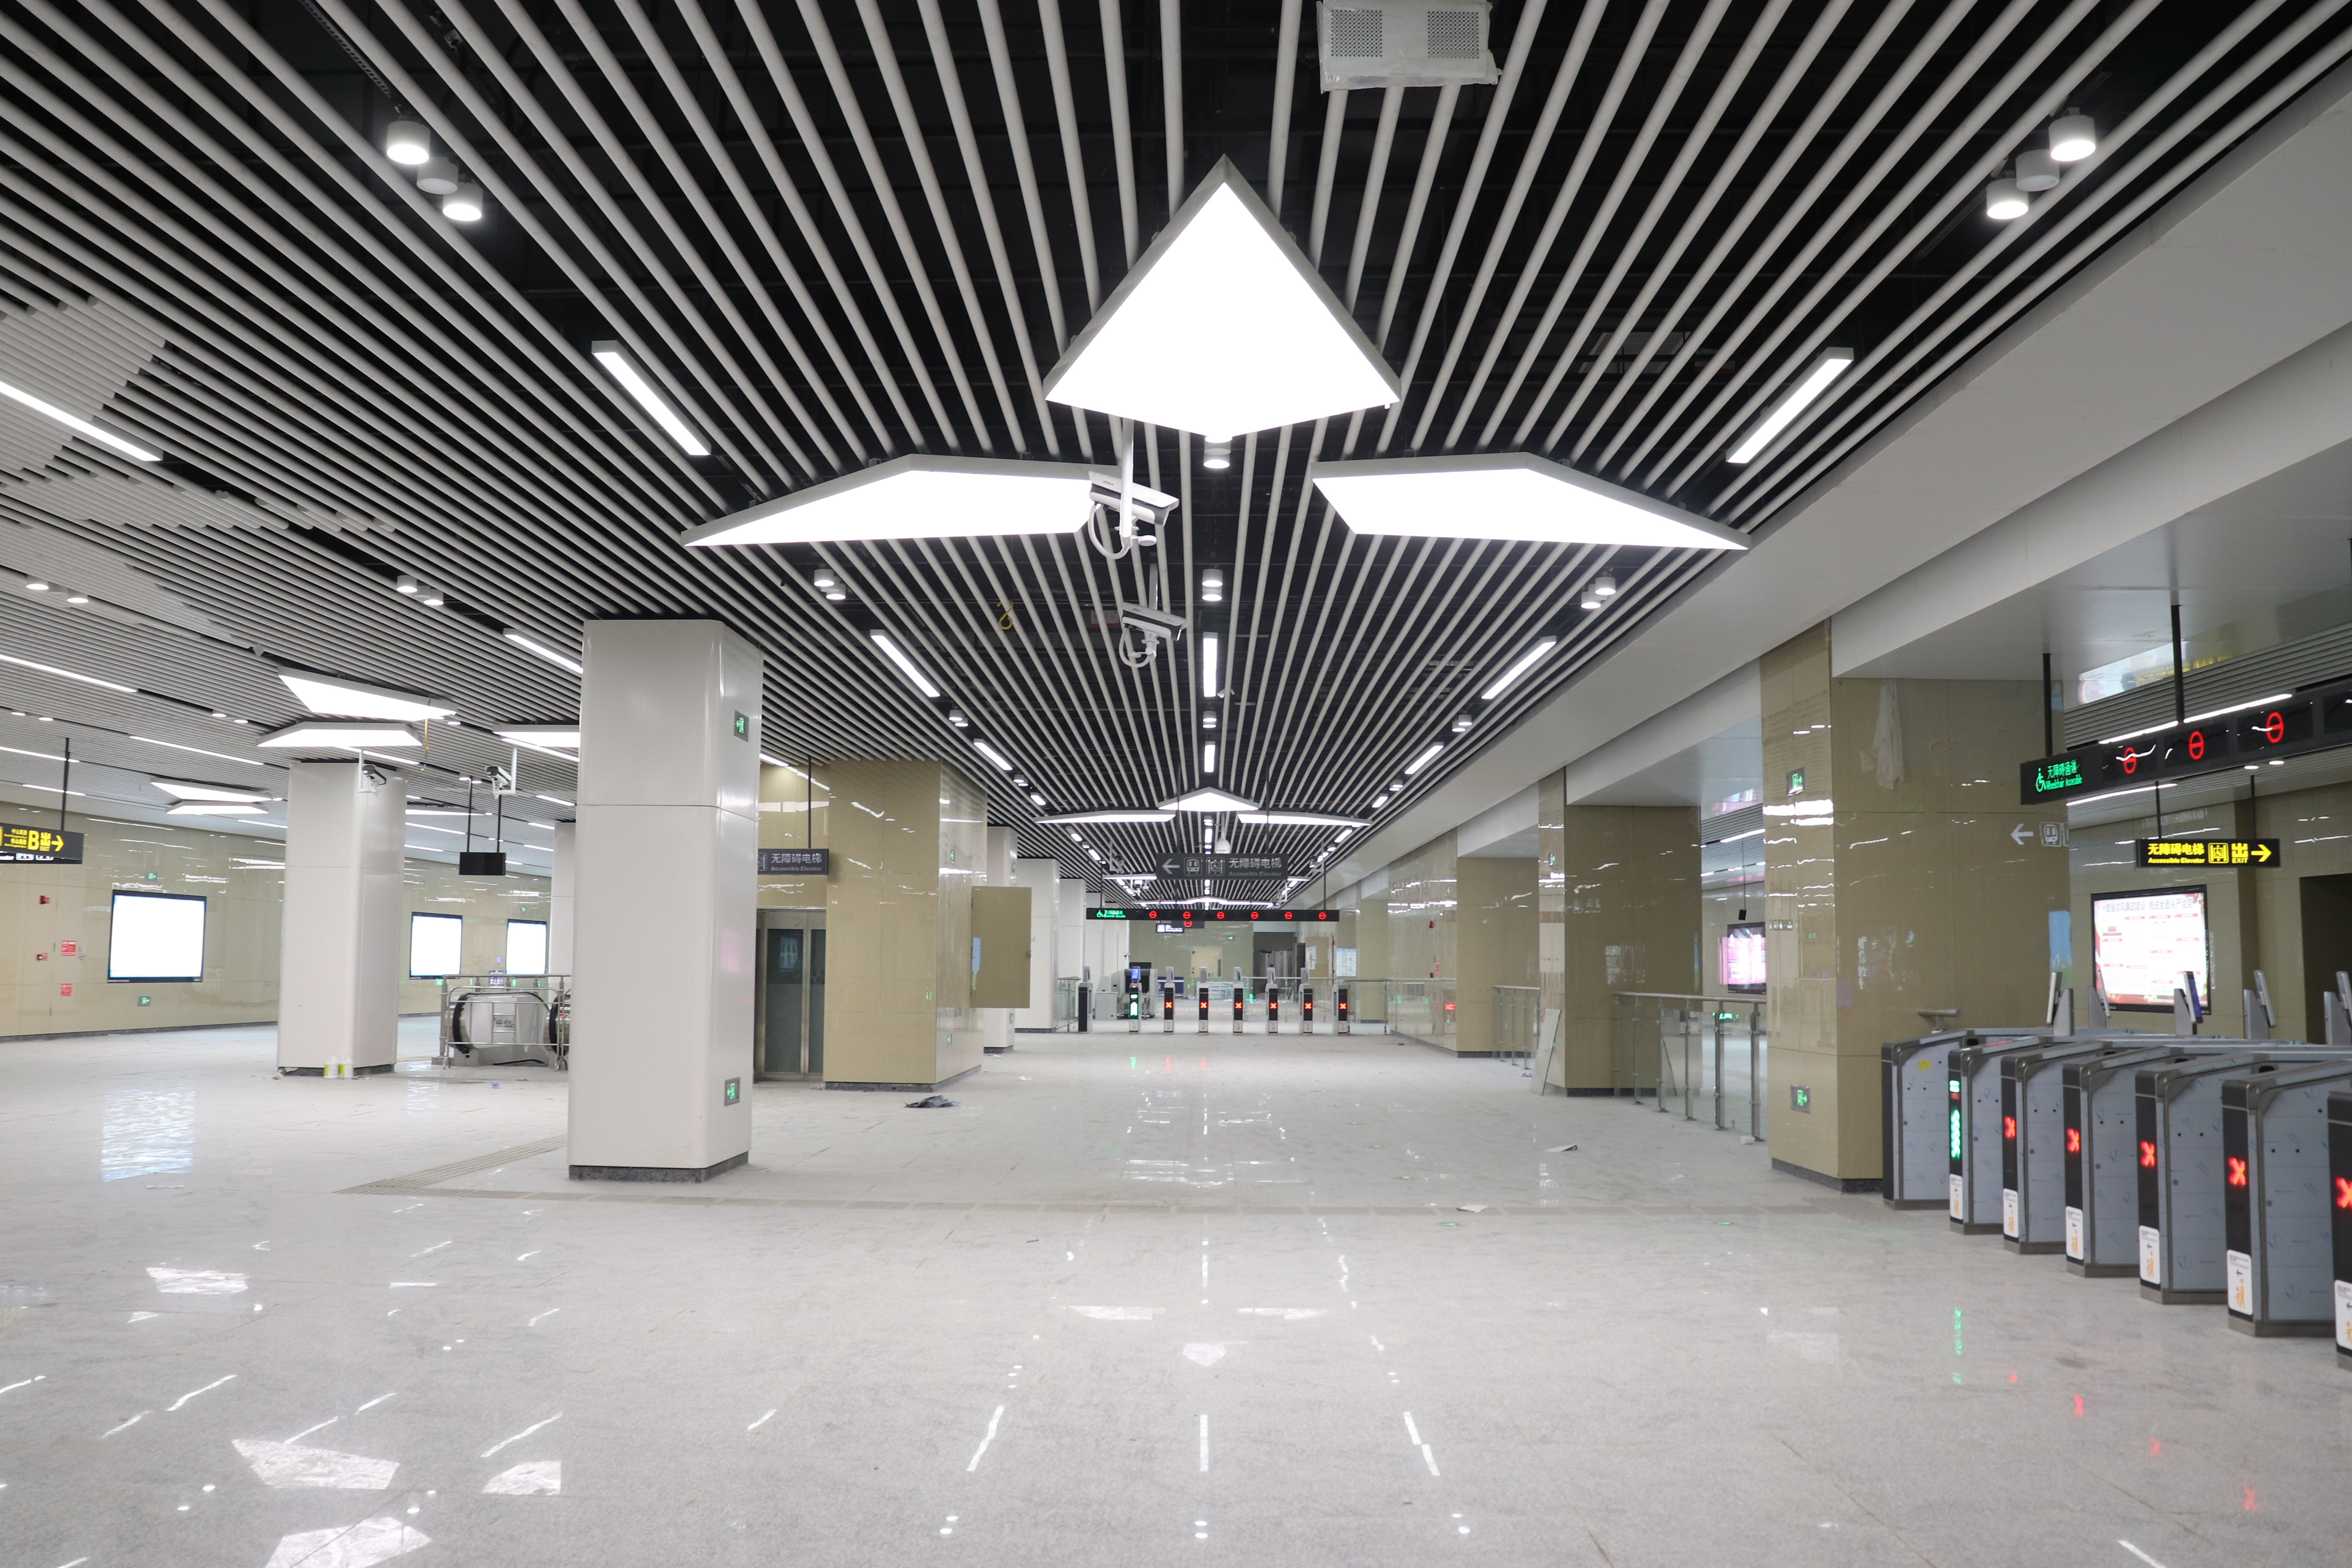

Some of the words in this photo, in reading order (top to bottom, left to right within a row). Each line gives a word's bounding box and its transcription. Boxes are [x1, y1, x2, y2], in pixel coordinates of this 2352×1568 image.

[2047, 759, 2077, 779] 无障碍通道
[28, 830, 39, 850] B
[40, 833, 51, 846] 出
[2148, 842, 2205, 856] 无障碍电梯
[2232, 843, 2249, 858] 出
[771, 853, 822, 864] 无障碍电梯
[1229, 857, 1281, 869] 无障碍电梯
